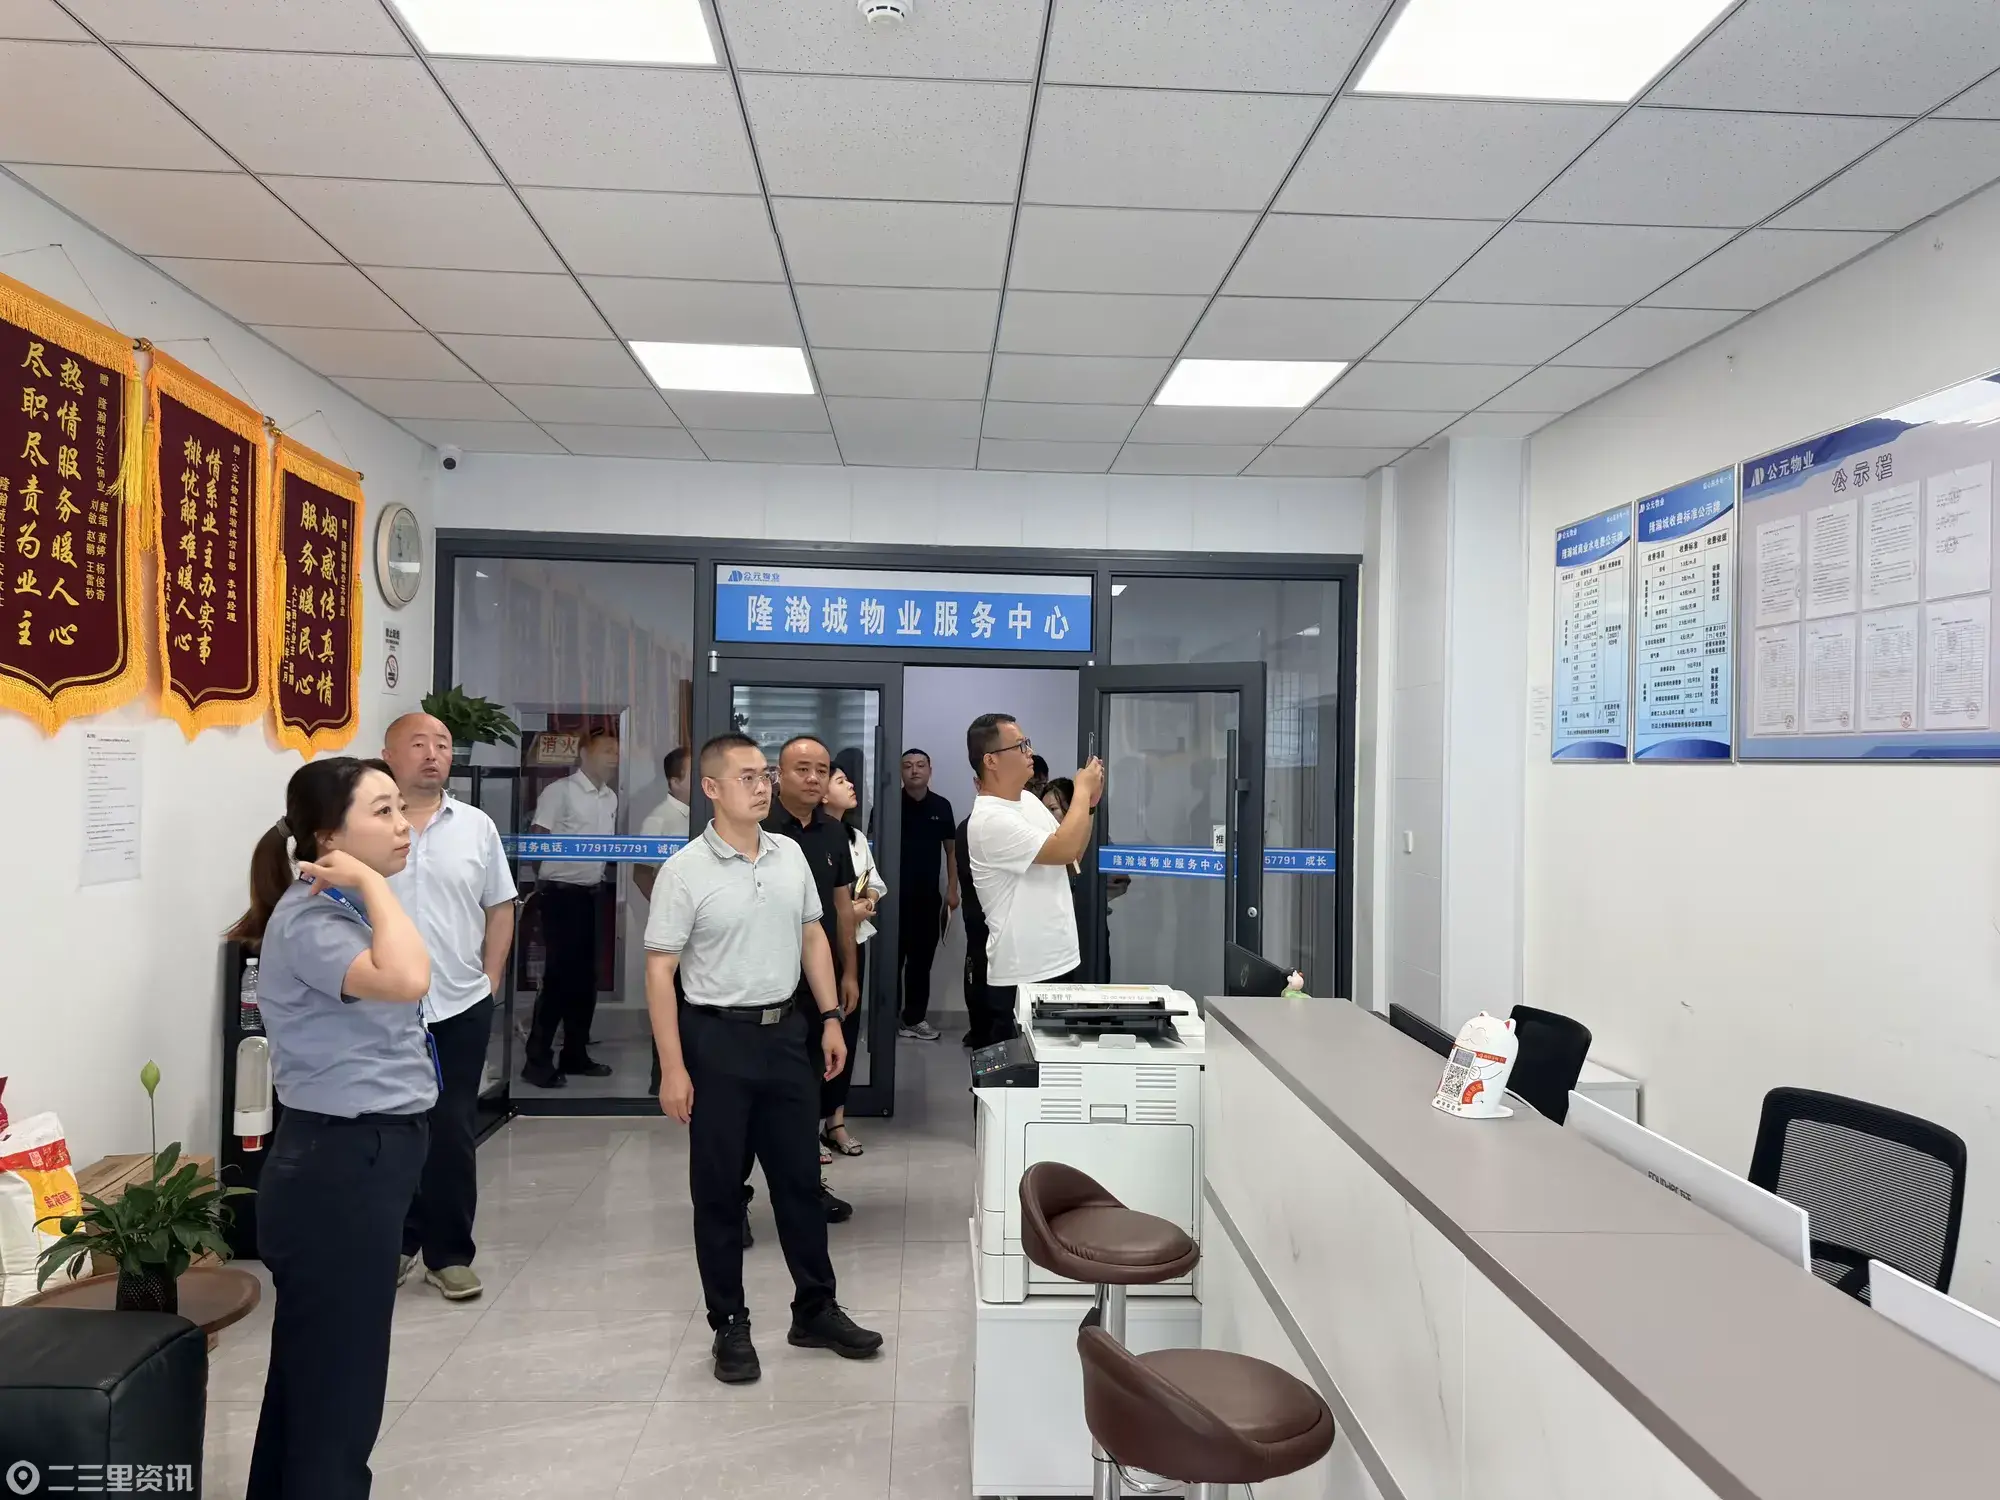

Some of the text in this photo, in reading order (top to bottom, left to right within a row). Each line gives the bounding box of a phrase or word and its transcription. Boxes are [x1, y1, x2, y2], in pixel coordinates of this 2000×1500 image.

[1767, 450, 1815, 481] 公元物业
[1832, 453, 1893, 493] 公示栏
[14, 341, 53, 647] 尽职尽责为业主
[48, 357, 86, 647] 热情服务暖人心
[174, 434, 203, 651] 排忧解难暖人心
[197, 447, 223, 666] 情系业主办实事
[294, 500, 319, 696] 服务暖民心
[316, 507, 338, 707] 烟感传真情
[747, 594, 1070, 640] 隆瀚城物业服务中心
[575, 843, 648, 853] 17791757791
[1215, 834, 1224, 844] 推
[1264, 855, 1327, 866] 57791 成长
[1113, 854, 1224, 871] 隆瀚城物业服务中心
